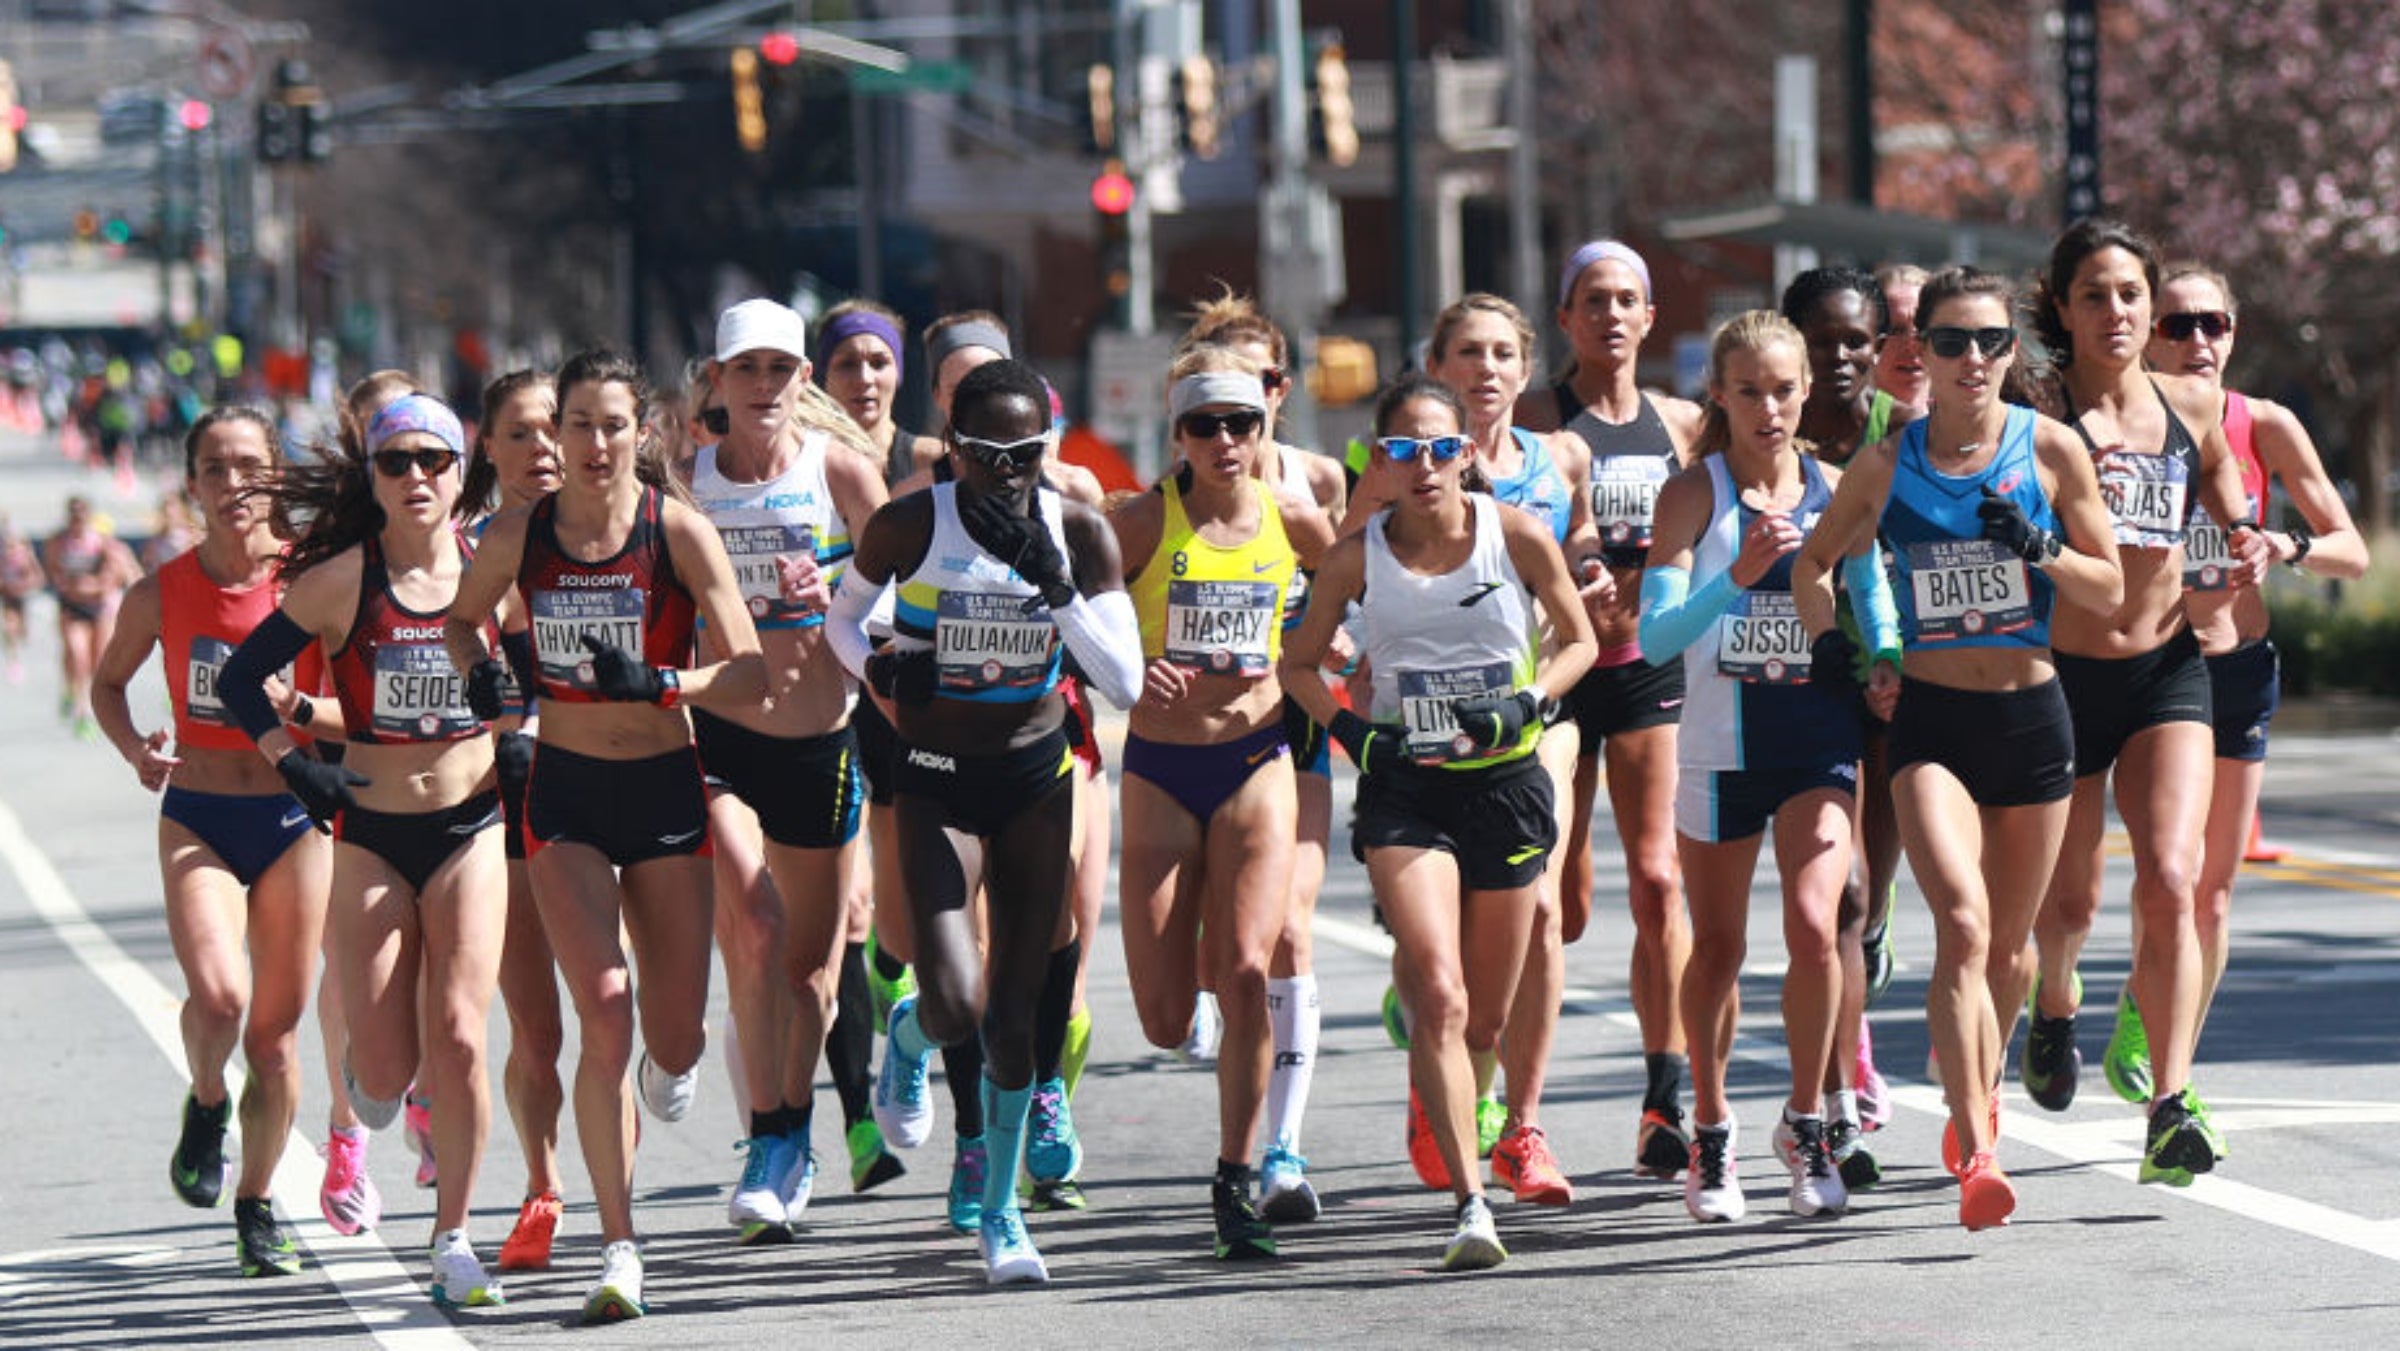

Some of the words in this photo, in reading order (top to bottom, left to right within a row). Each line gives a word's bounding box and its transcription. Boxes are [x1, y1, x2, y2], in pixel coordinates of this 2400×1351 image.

[2101, 484, 2172, 520] OJAS
[1172, 551, 1188, 576] 8
[1929, 565, 2010, 607] BATES
[942, 625, 1050, 654] TULIAMUK
[1183, 609, 1263, 646] HASAY
[1731, 619, 1812, 654] SISSO
[908, 749, 956, 773] HOKA
